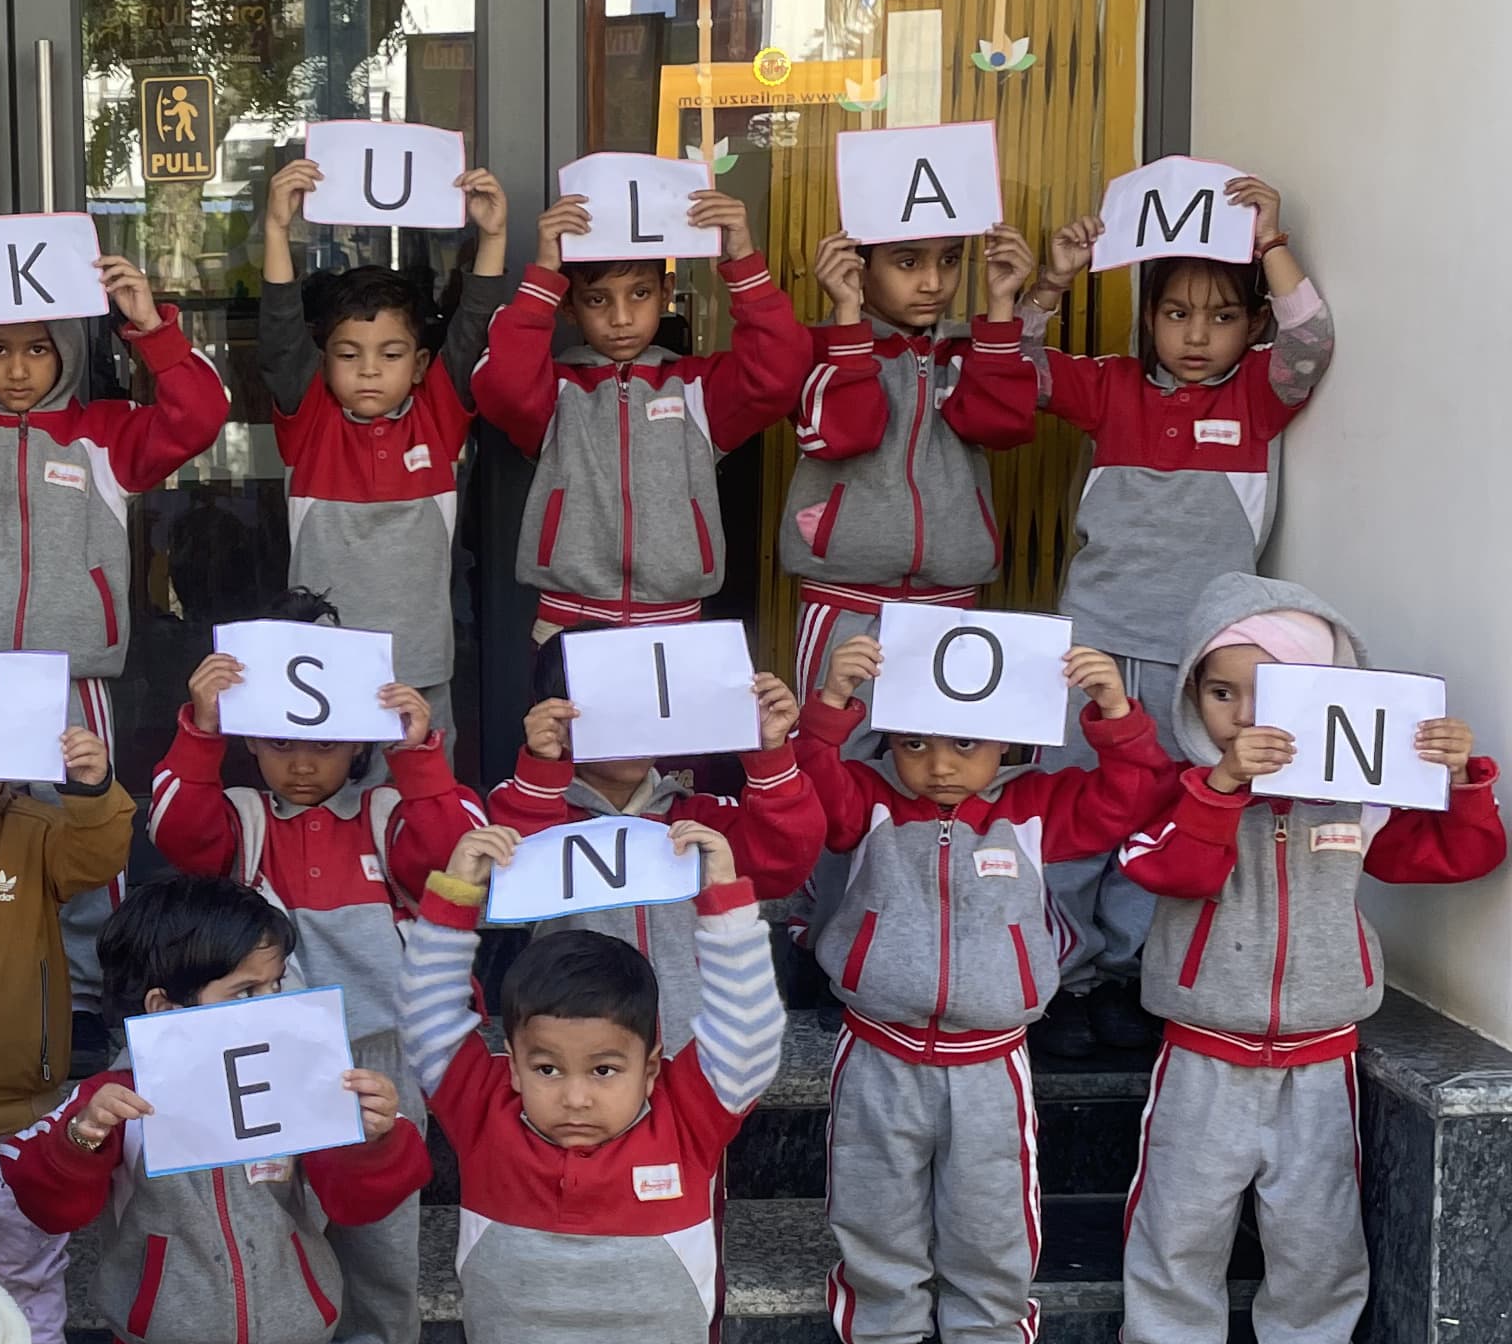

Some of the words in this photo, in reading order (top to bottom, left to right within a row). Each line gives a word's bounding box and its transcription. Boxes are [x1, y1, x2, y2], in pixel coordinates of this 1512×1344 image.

[152, 154, 208, 172] PULL
[364, 149, 412, 210] U
[901, 159, 956, 222] A
[630, 181, 663, 242] L
[1136, 189, 1214, 247] M
[8, 243, 55, 305] K
[287, 656, 330, 726] S
[654, 643, 670, 718] I
[934, 627, 1003, 701] O
[1325, 705, 1385, 785] N
[563, 828, 628, 899] N
[224, 1043, 281, 1140] E
